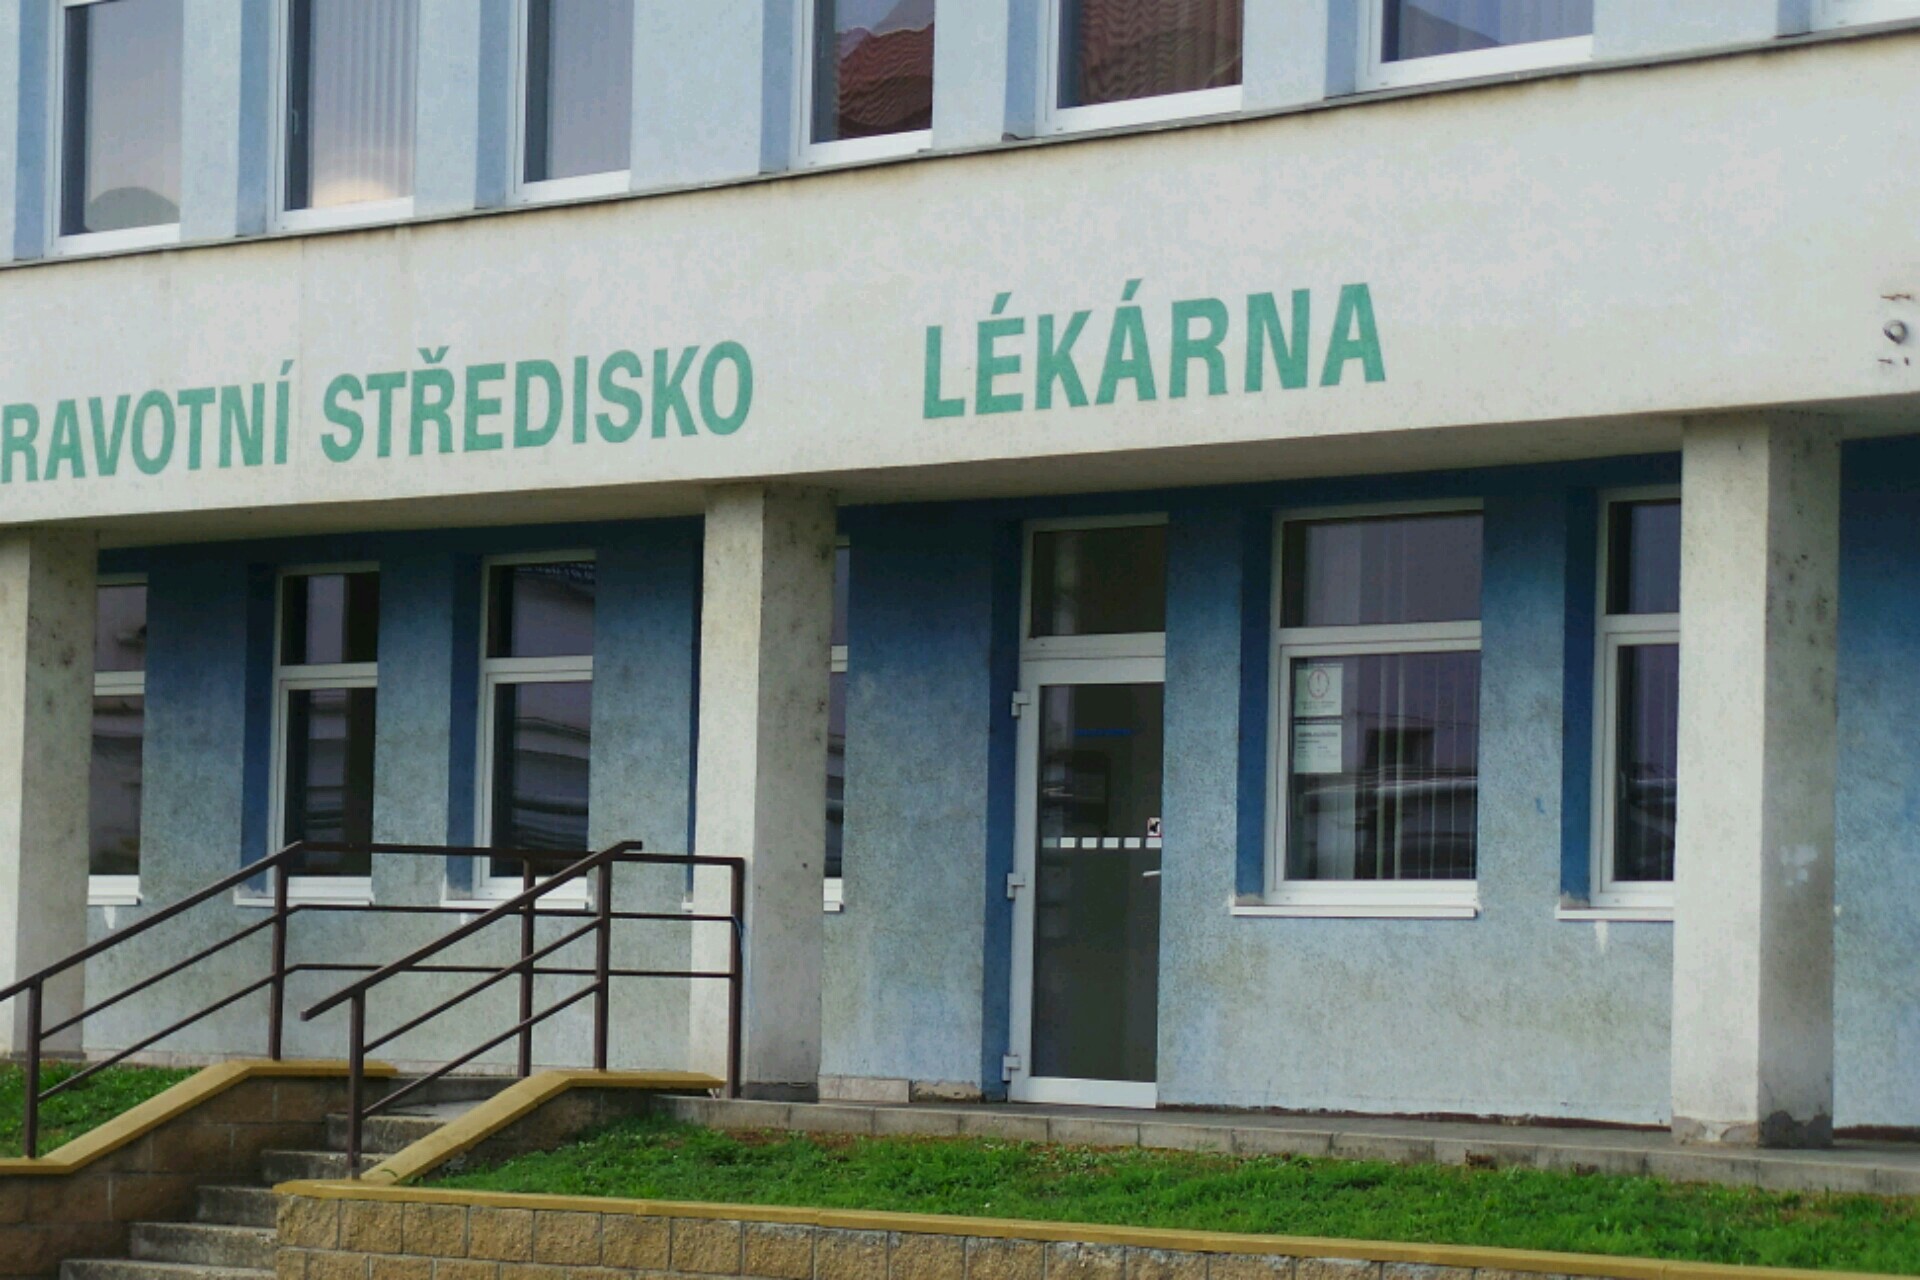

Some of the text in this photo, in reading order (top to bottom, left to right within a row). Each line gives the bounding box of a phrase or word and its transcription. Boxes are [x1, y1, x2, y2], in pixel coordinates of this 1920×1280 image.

[0, 341, 752, 484] RAVOTNÍ STŘEDISKO
[923, 279, 1387, 420] LÉKÁRNA
